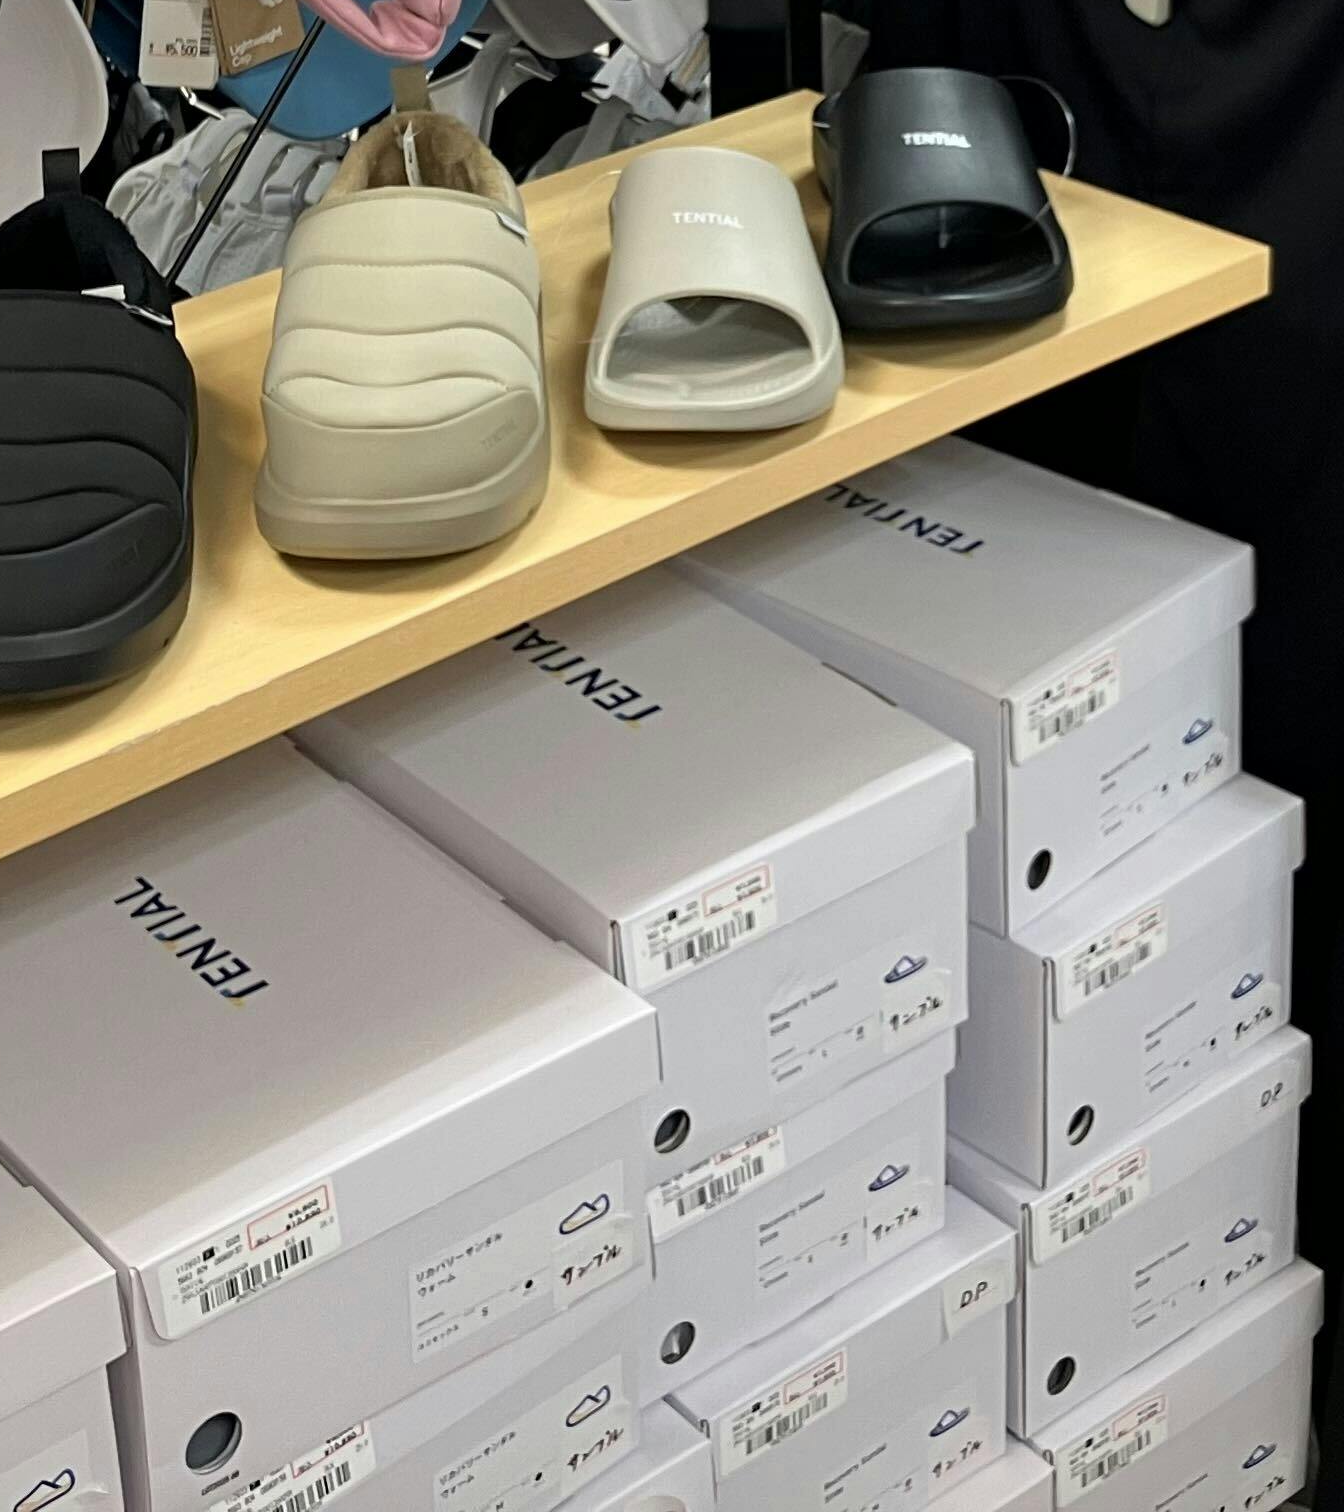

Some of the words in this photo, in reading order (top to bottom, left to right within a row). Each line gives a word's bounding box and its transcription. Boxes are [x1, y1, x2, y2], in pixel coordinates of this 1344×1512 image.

[903, 130, 972, 149] TENTIAL
[672, 210, 743, 230] TENTIAL
[824, 483, 985, 559] TENTIAL
[112, 875, 270, 1010] TENTIAL
[415, 1232, 504, 1284] リカバリーサンダル
[959, 1280, 989, 1309] DP
